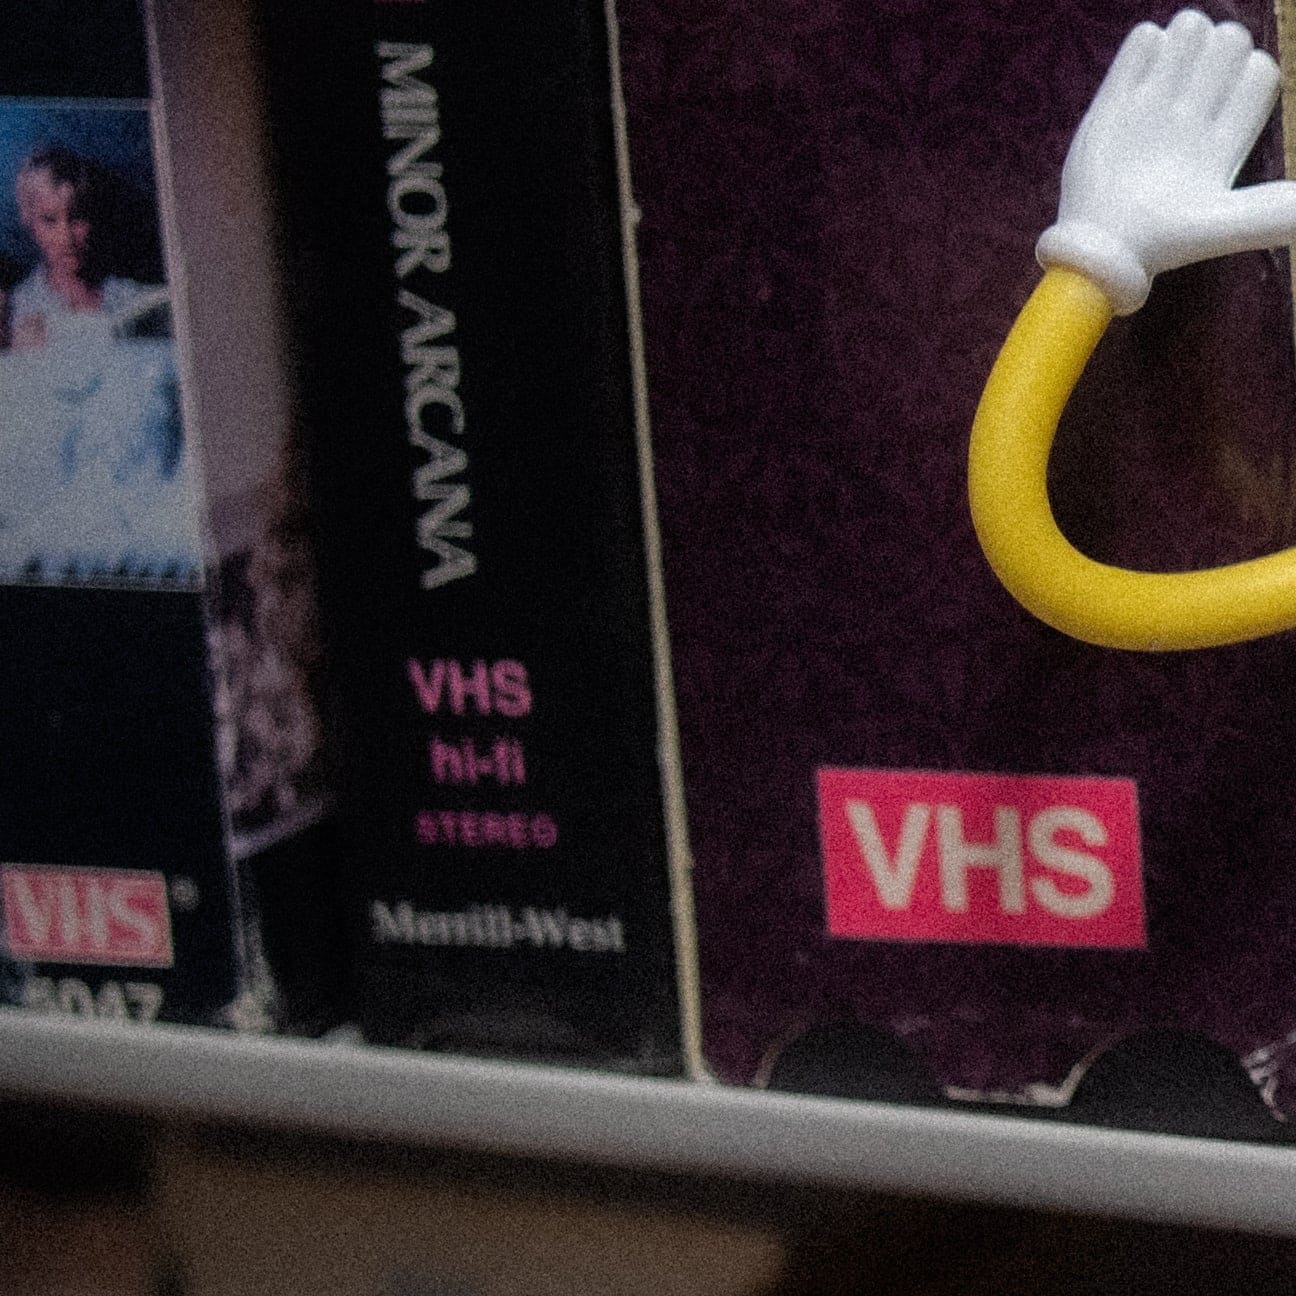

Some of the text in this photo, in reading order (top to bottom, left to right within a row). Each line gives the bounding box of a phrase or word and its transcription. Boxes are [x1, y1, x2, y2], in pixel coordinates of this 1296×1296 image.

[375, 39, 480, 591] MINOR ARCANA
[406, 657, 535, 719] VHS
[428, 735, 528, 786] hi-fi
[413, 811, 560, 850] STEREO
[843, 797, 1117, 921] VHS
[12, 870, 163, 950] VHS
[370, 899, 627, 954] Merrill-West
